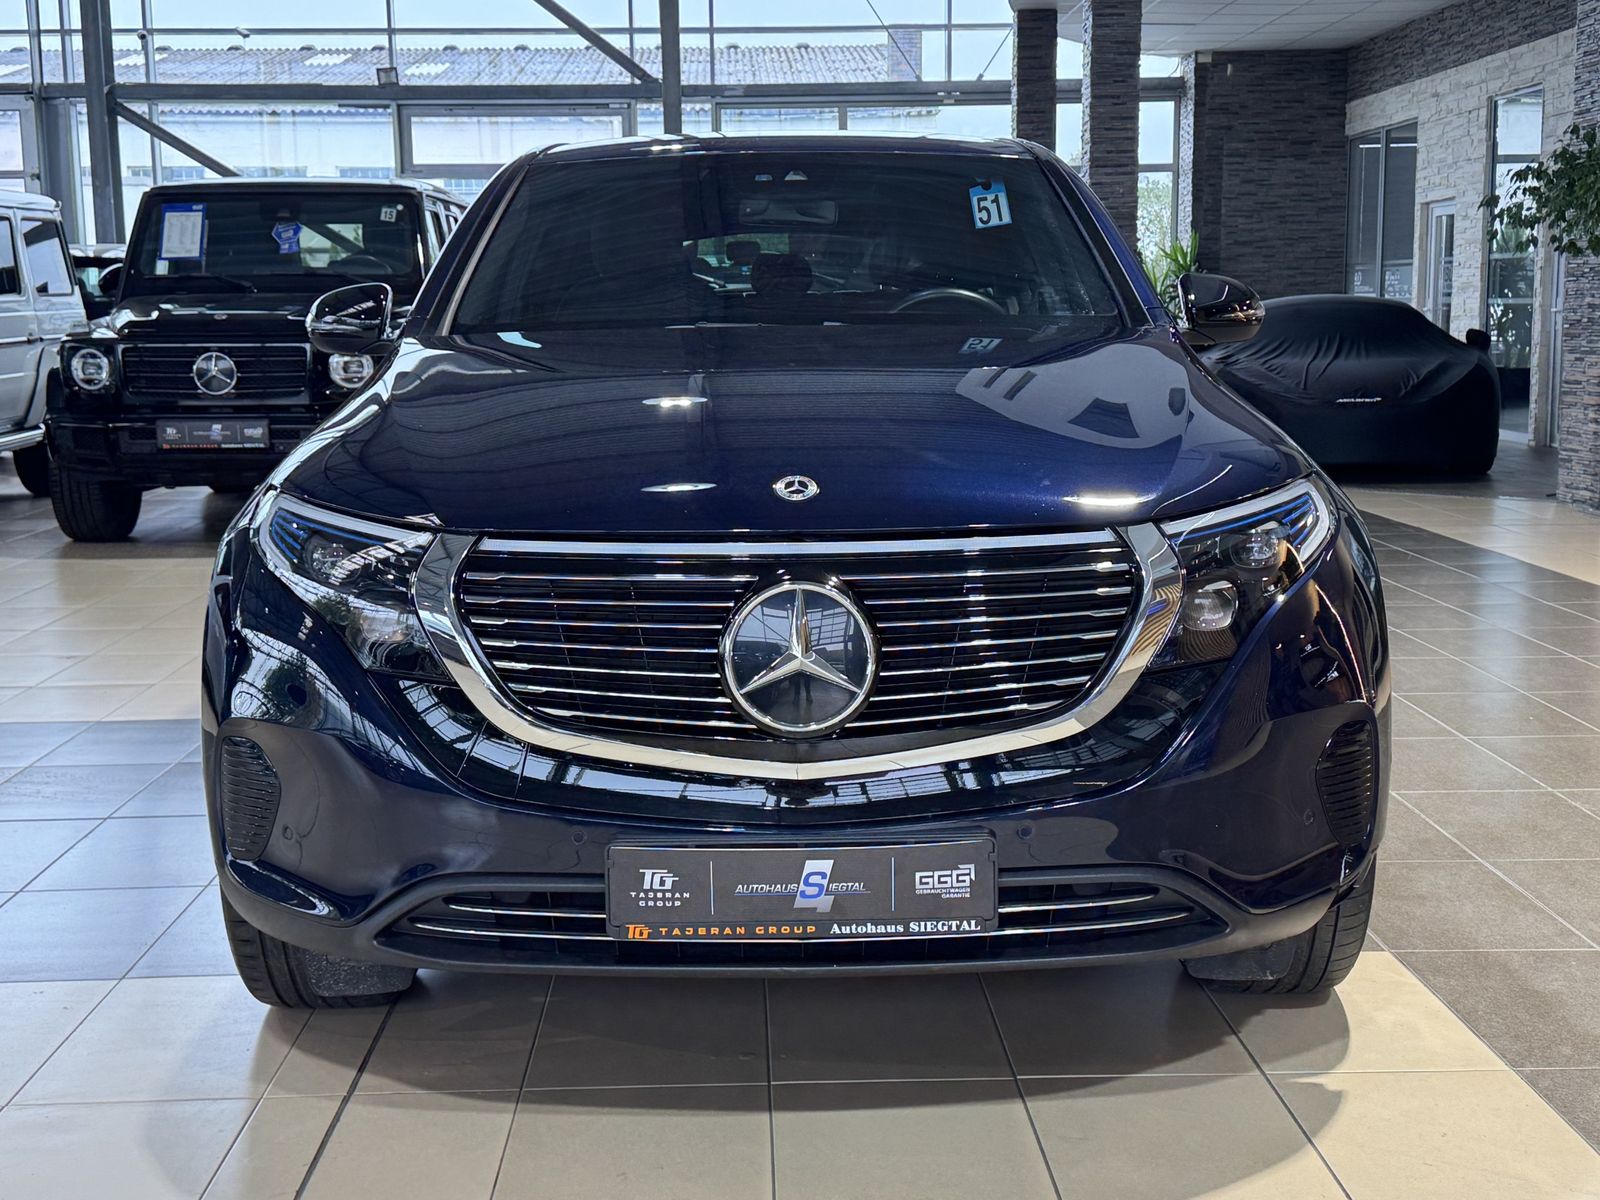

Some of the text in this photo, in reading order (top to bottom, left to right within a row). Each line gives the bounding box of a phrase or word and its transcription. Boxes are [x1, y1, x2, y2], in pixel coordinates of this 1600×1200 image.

[384, 210, 394, 220] 15
[977, 194, 1003, 225] 51
[639, 868, 679, 889] TG
[915, 868, 971, 889] GGG
[735, 884, 798, 893] AUTOHAUS
[915, 887, 971, 895] GEBRAUCHTWAGEN
[625, 924, 816, 939] TG TAJERAN GROUP
[830, 920, 981, 934] Autohaus SIEGTAL
